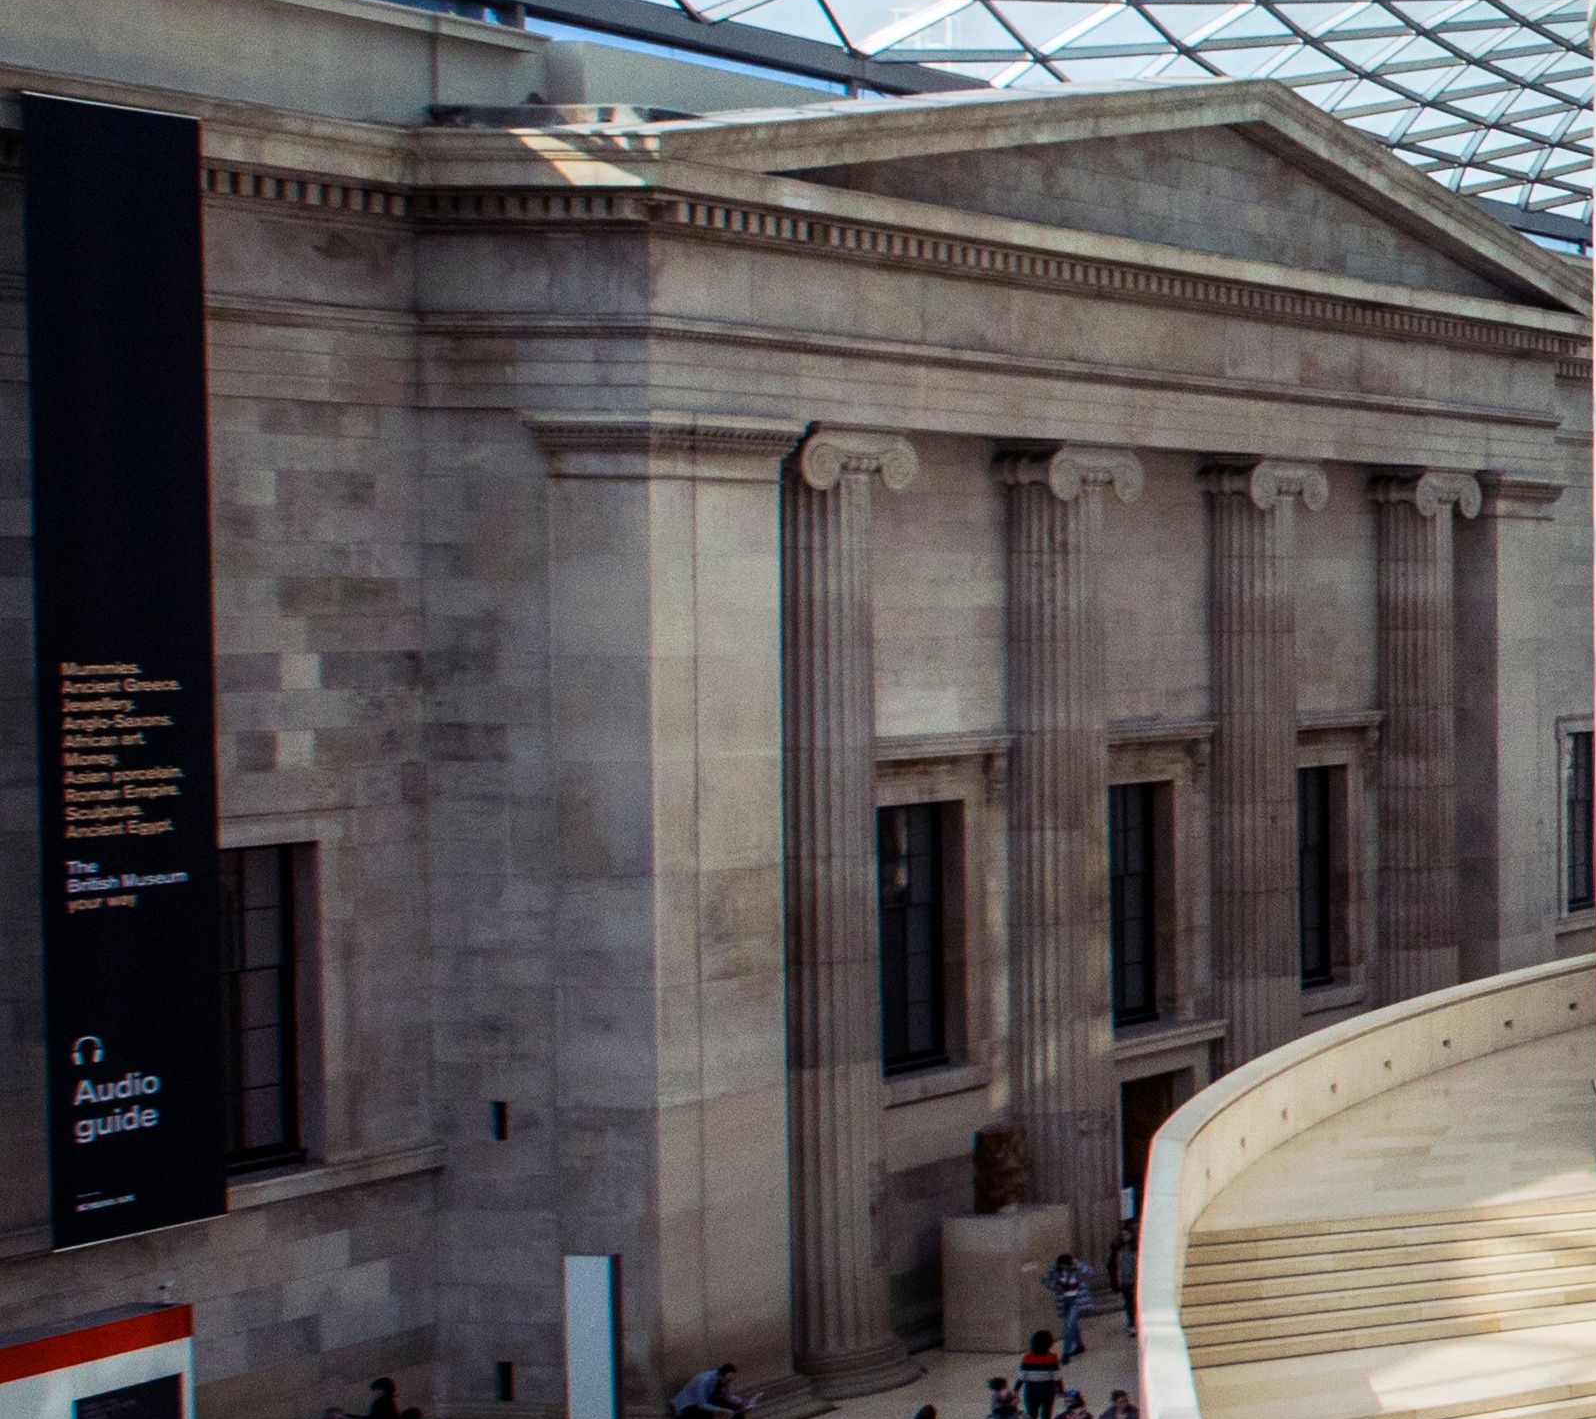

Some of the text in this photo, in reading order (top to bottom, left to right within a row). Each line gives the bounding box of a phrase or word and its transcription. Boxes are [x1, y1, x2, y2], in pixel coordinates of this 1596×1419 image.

[65, 861, 99, 874] The
[71, 1071, 161, 1106] Audio
[73, 1105, 160, 1144] guide
